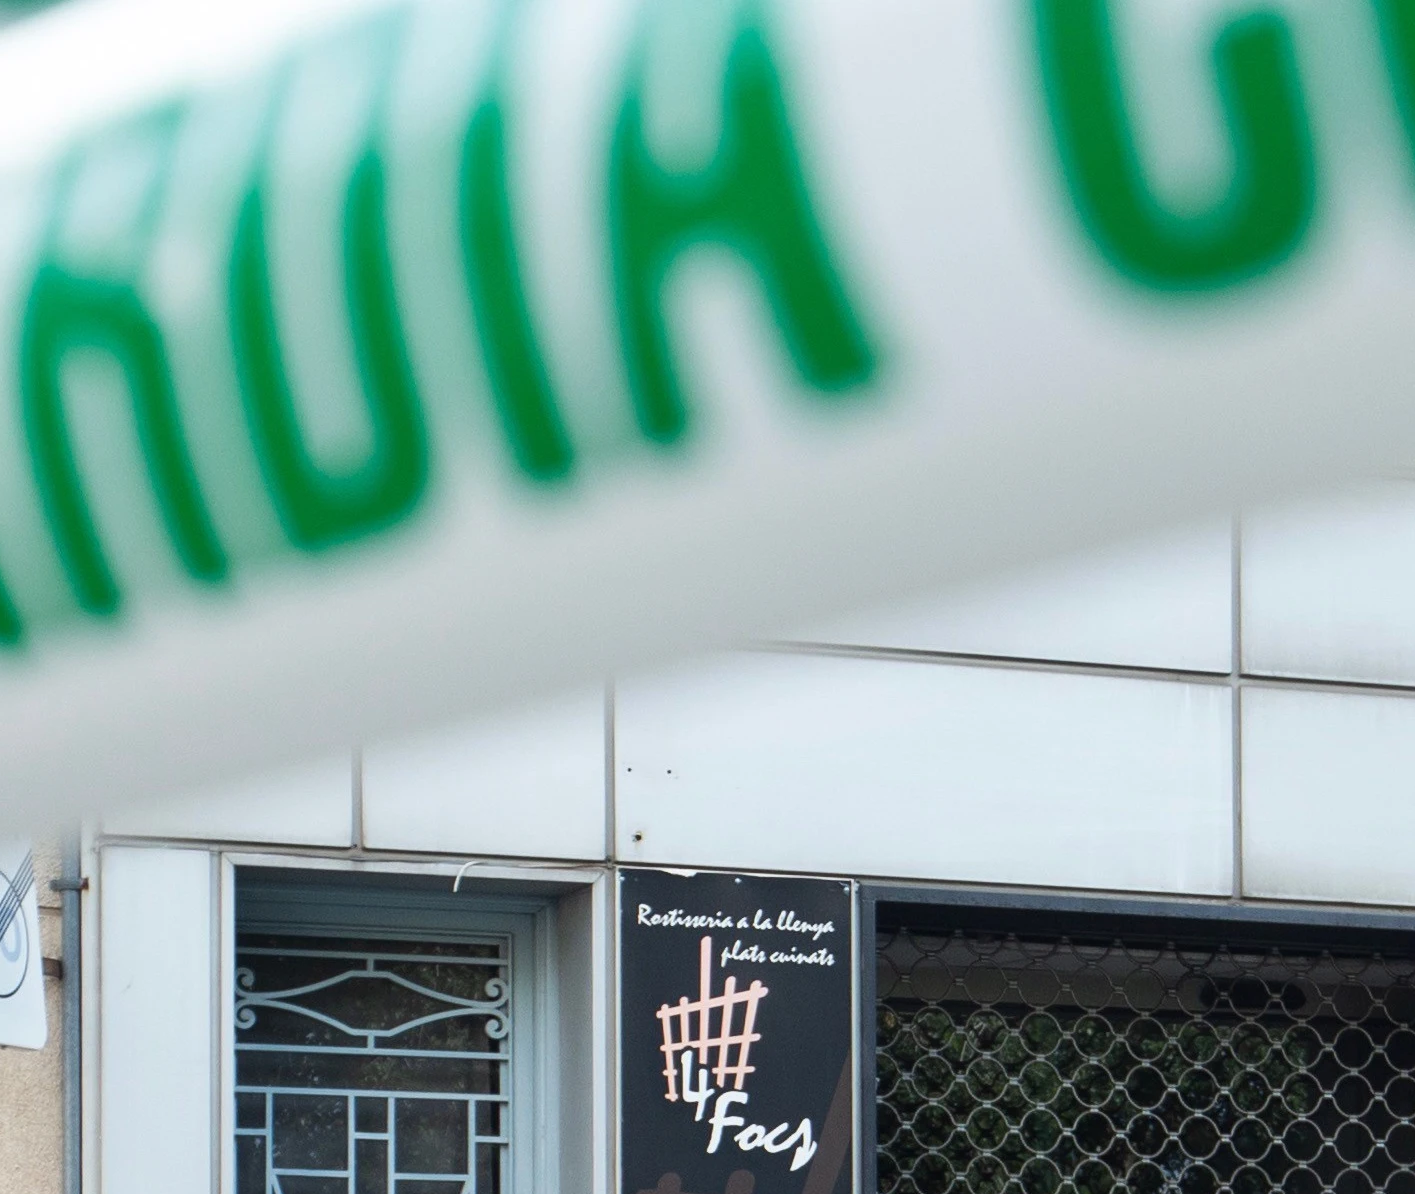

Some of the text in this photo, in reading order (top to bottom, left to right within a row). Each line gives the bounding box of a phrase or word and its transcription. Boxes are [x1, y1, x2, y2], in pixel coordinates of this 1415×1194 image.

[638, 904, 835, 941] Rostisseria a la llenya
[721, 940, 836, 967] plats cuinats
[681, 1050, 714, 1121] 4
[706, 1091, 818, 1171] Focs
